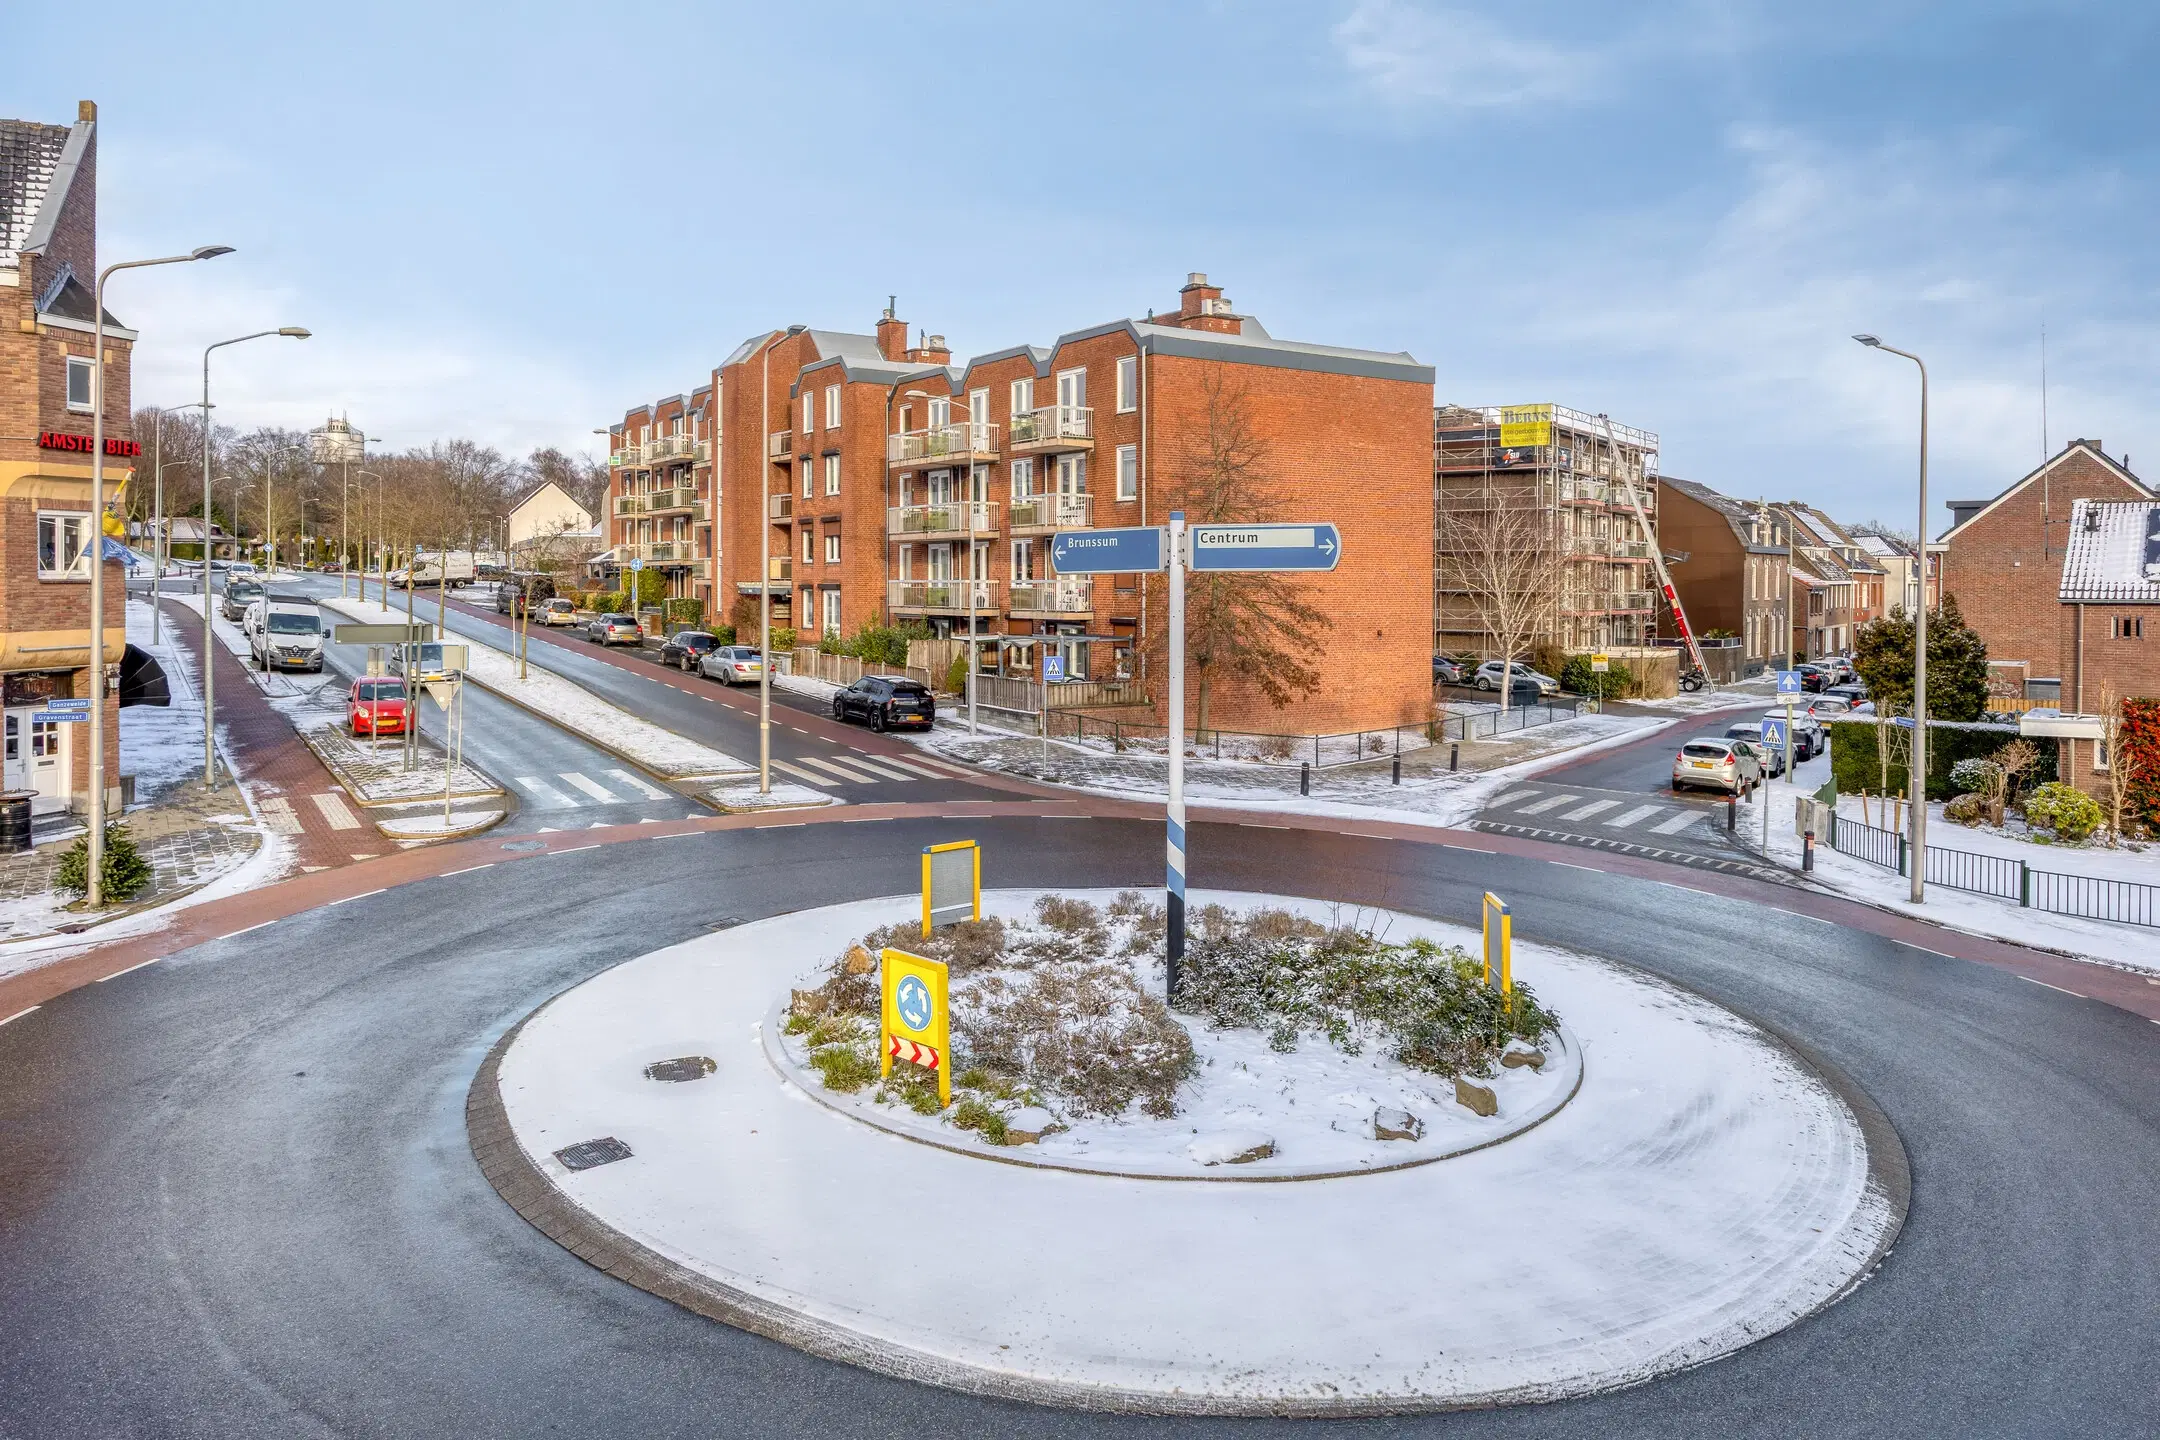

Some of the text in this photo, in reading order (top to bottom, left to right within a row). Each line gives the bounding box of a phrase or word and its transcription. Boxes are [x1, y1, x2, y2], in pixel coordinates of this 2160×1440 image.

[1504, 410, 1549, 424] BERNS
[40, 432, 141, 456] AMSTE BIER
[1068, 536, 1118, 548] Brunssum
[1200, 532, 1259, 544] Centrum
